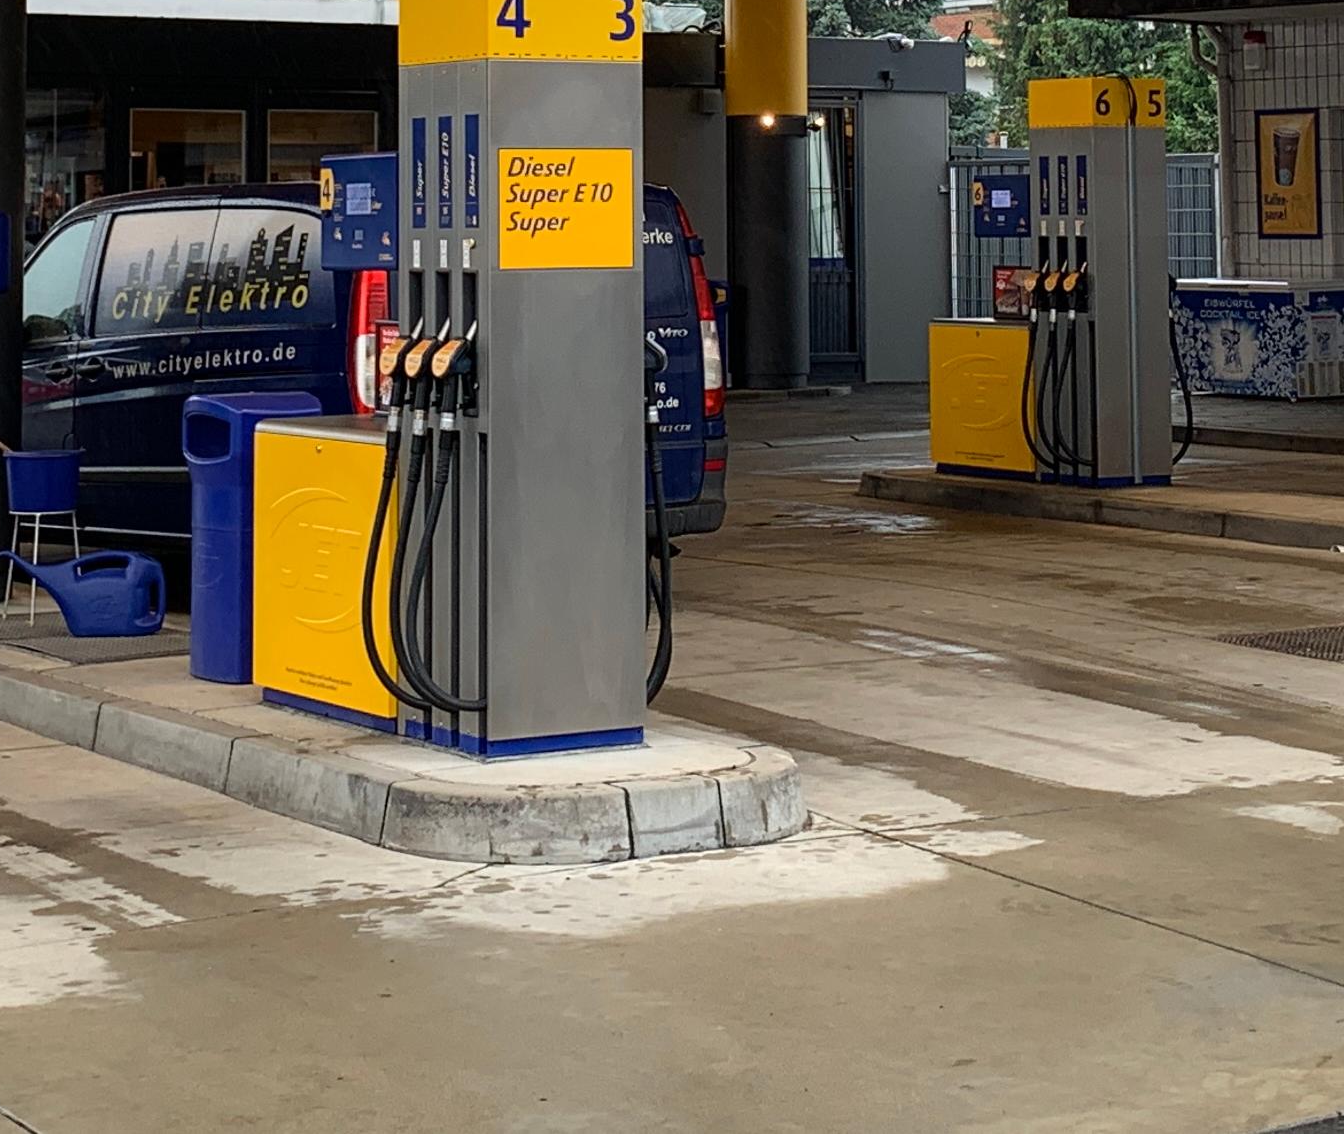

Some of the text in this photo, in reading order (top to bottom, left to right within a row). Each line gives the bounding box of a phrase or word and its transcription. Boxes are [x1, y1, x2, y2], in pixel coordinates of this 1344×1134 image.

[1095, 88, 1163, 118] 6 5
[415, 160, 424, 199] Super
[441, 132, 450, 199] Super E10
[468, 154, 477, 197] Diesel
[507, 156, 576, 177] Diesel
[322, 177, 332, 203] 4
[505, 183, 570, 210] Super
[974, 187, 981, 200] 6
[506, 211, 570, 239] Super
[111, 282, 309, 323] City Elektro
[111, 342, 297, 380] www.cityelektro.de
[654, 381, 666, 394] 76
